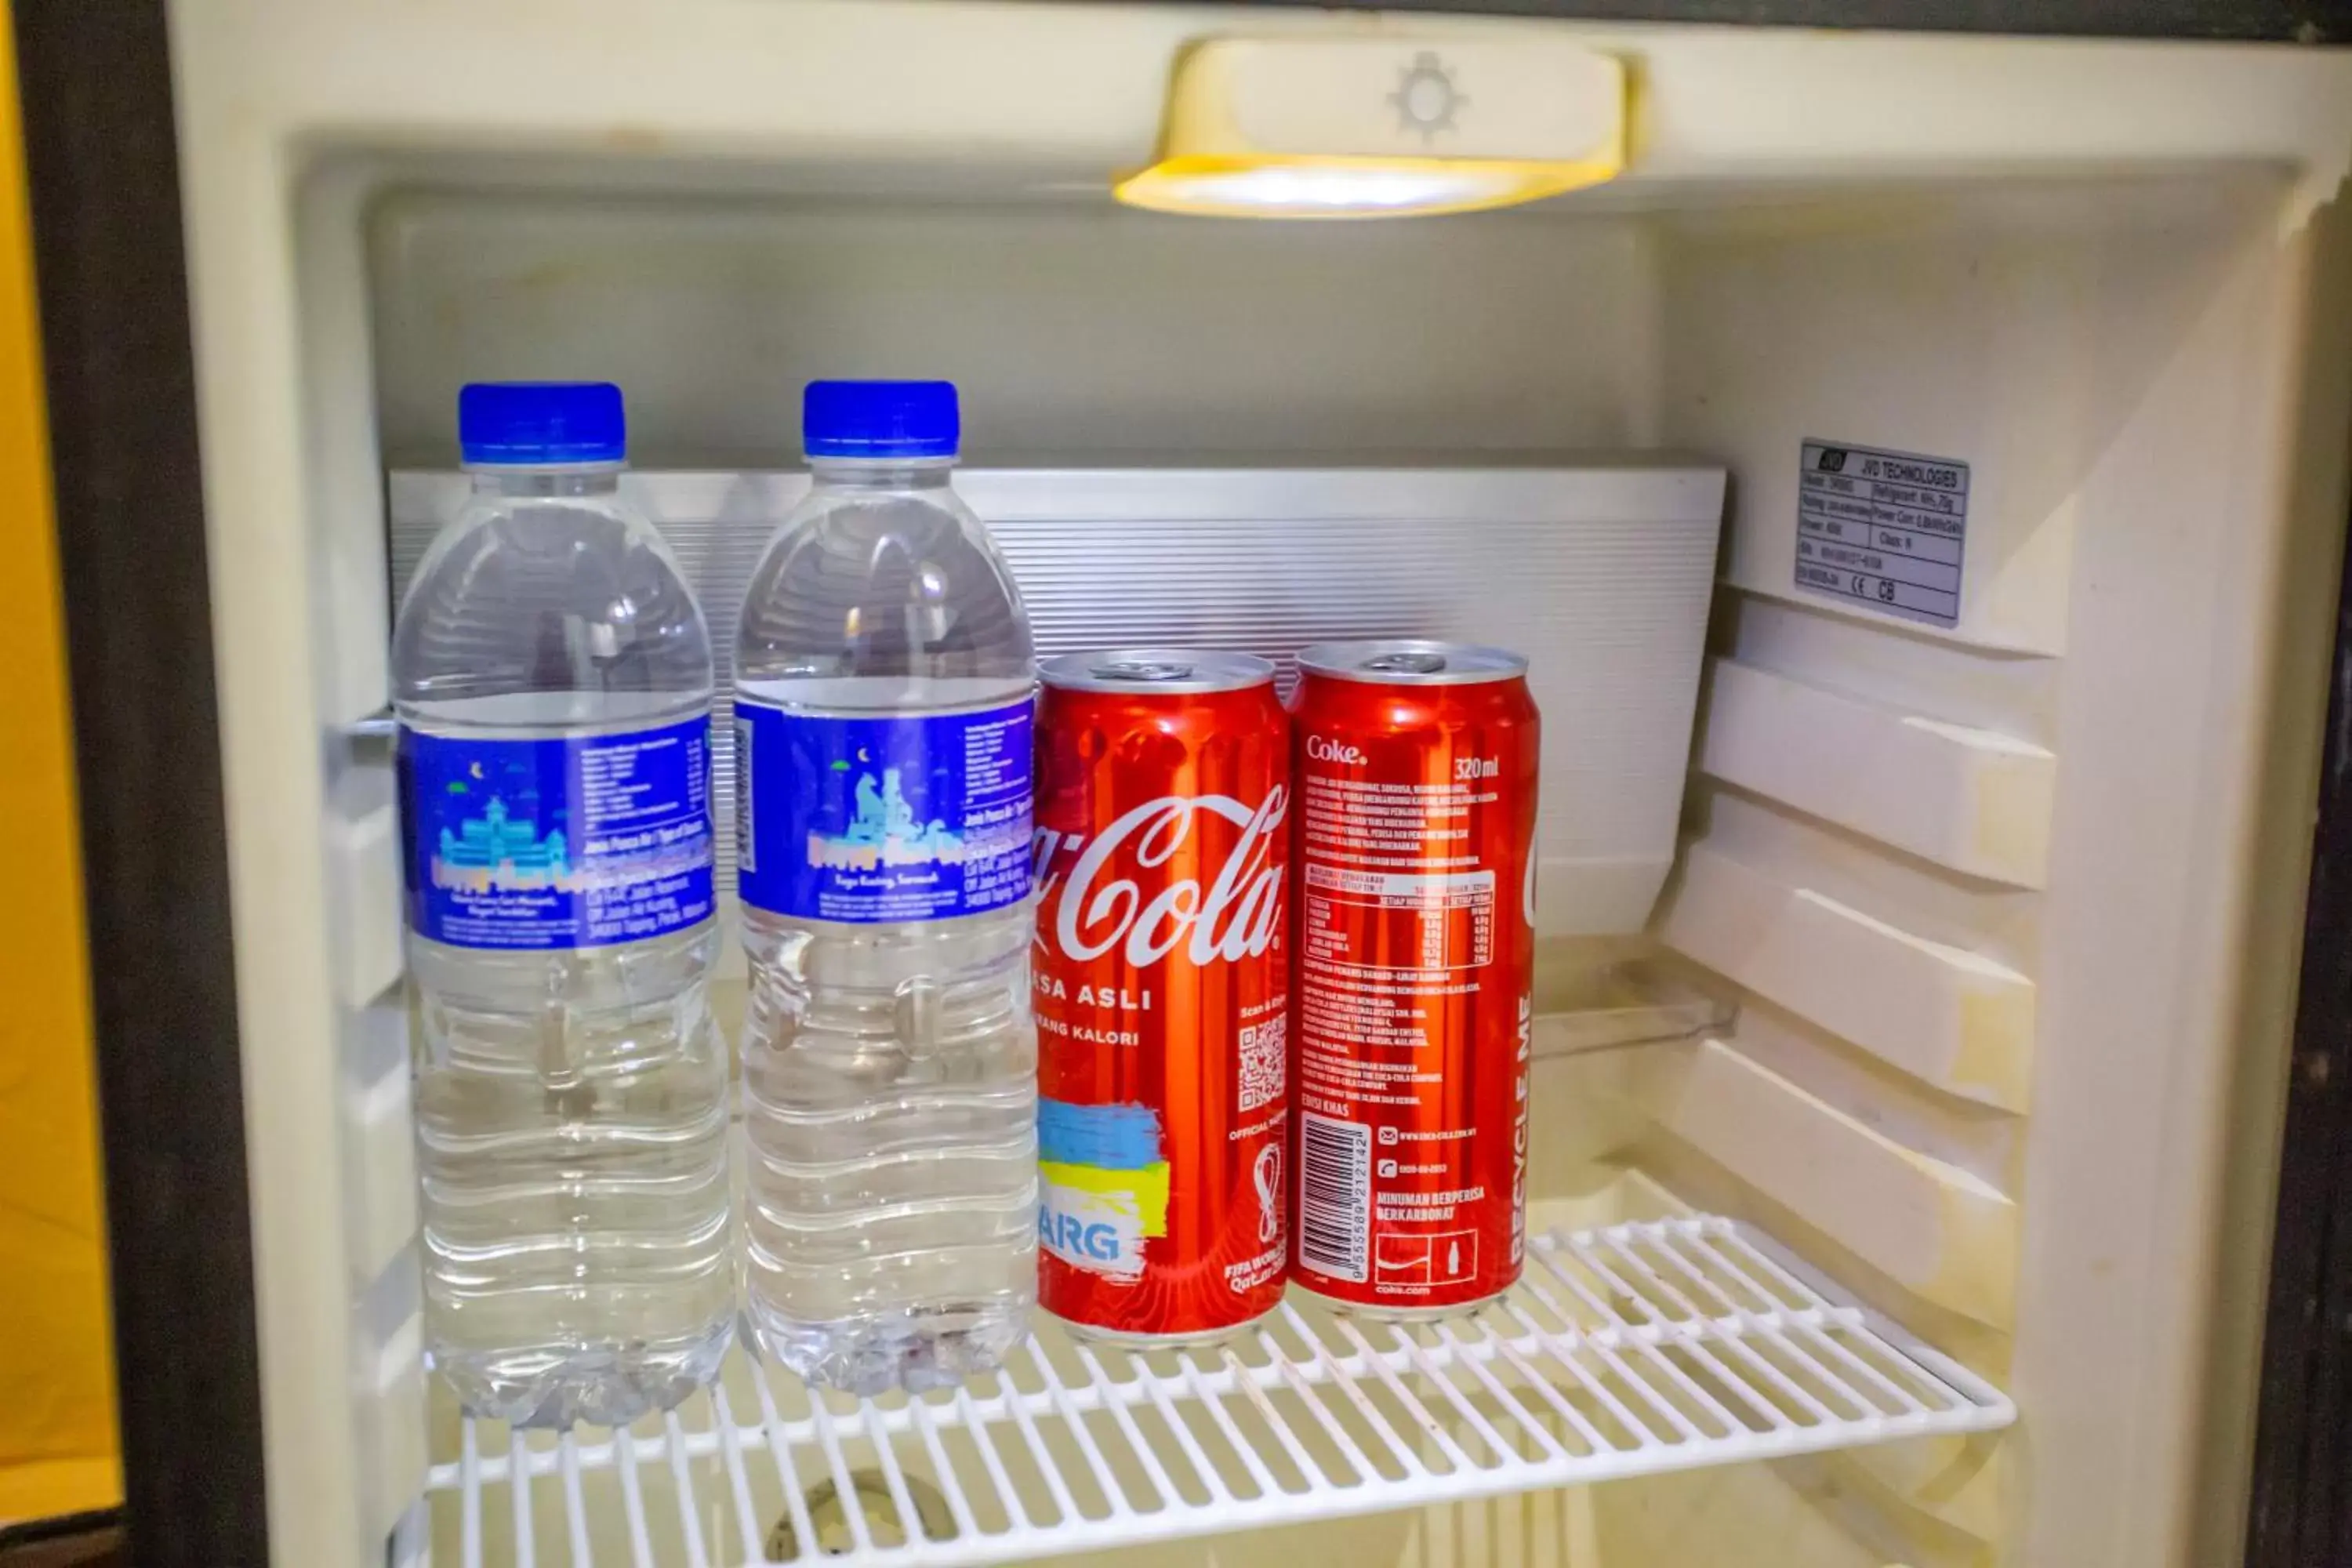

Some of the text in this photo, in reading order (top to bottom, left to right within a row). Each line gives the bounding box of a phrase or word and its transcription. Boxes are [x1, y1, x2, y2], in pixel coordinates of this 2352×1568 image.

[1882, 461, 1958, 488] TECHNOLOGIES
[1077, 984, 1151, 1010] ASLI
[1073, 1025, 1139, 1046] KALORI
[1323, 1099, 1349, 1117] KHAS
[1229, 1121, 1269, 1141] OFFICIAL
[1511, 1069, 1529, 1265] RECYCLE
[1377, 1191, 1430, 1206] MINUMAN
[1039, 1203, 1119, 1261] ARG
[1225, 1260, 1252, 1279] FIFA
